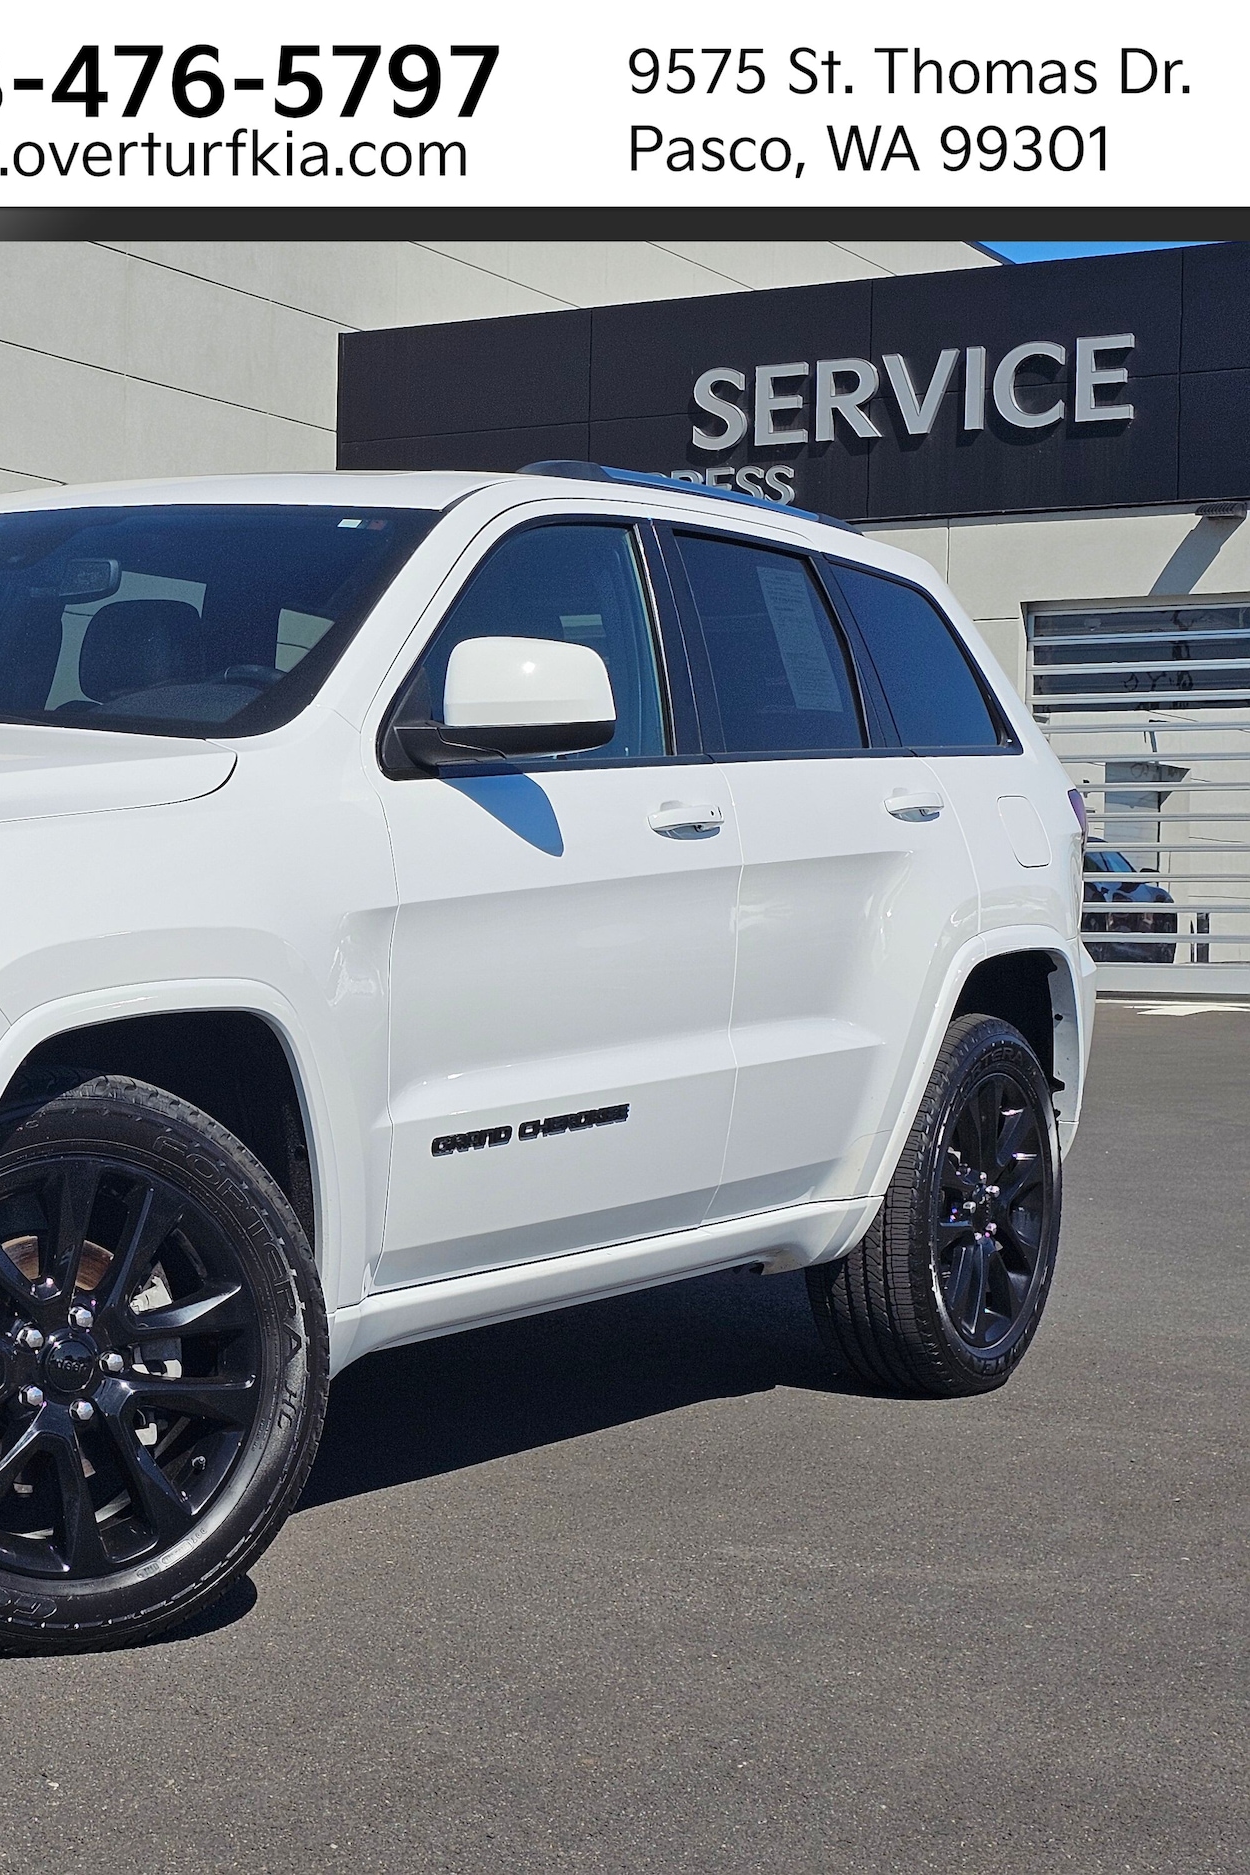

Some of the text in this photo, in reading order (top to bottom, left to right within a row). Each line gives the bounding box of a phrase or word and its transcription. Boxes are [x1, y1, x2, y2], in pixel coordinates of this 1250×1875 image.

[692, 332, 1136, 451] SERVICE
[431, 1103, 630, 1157] GRAND CHEROKEE
